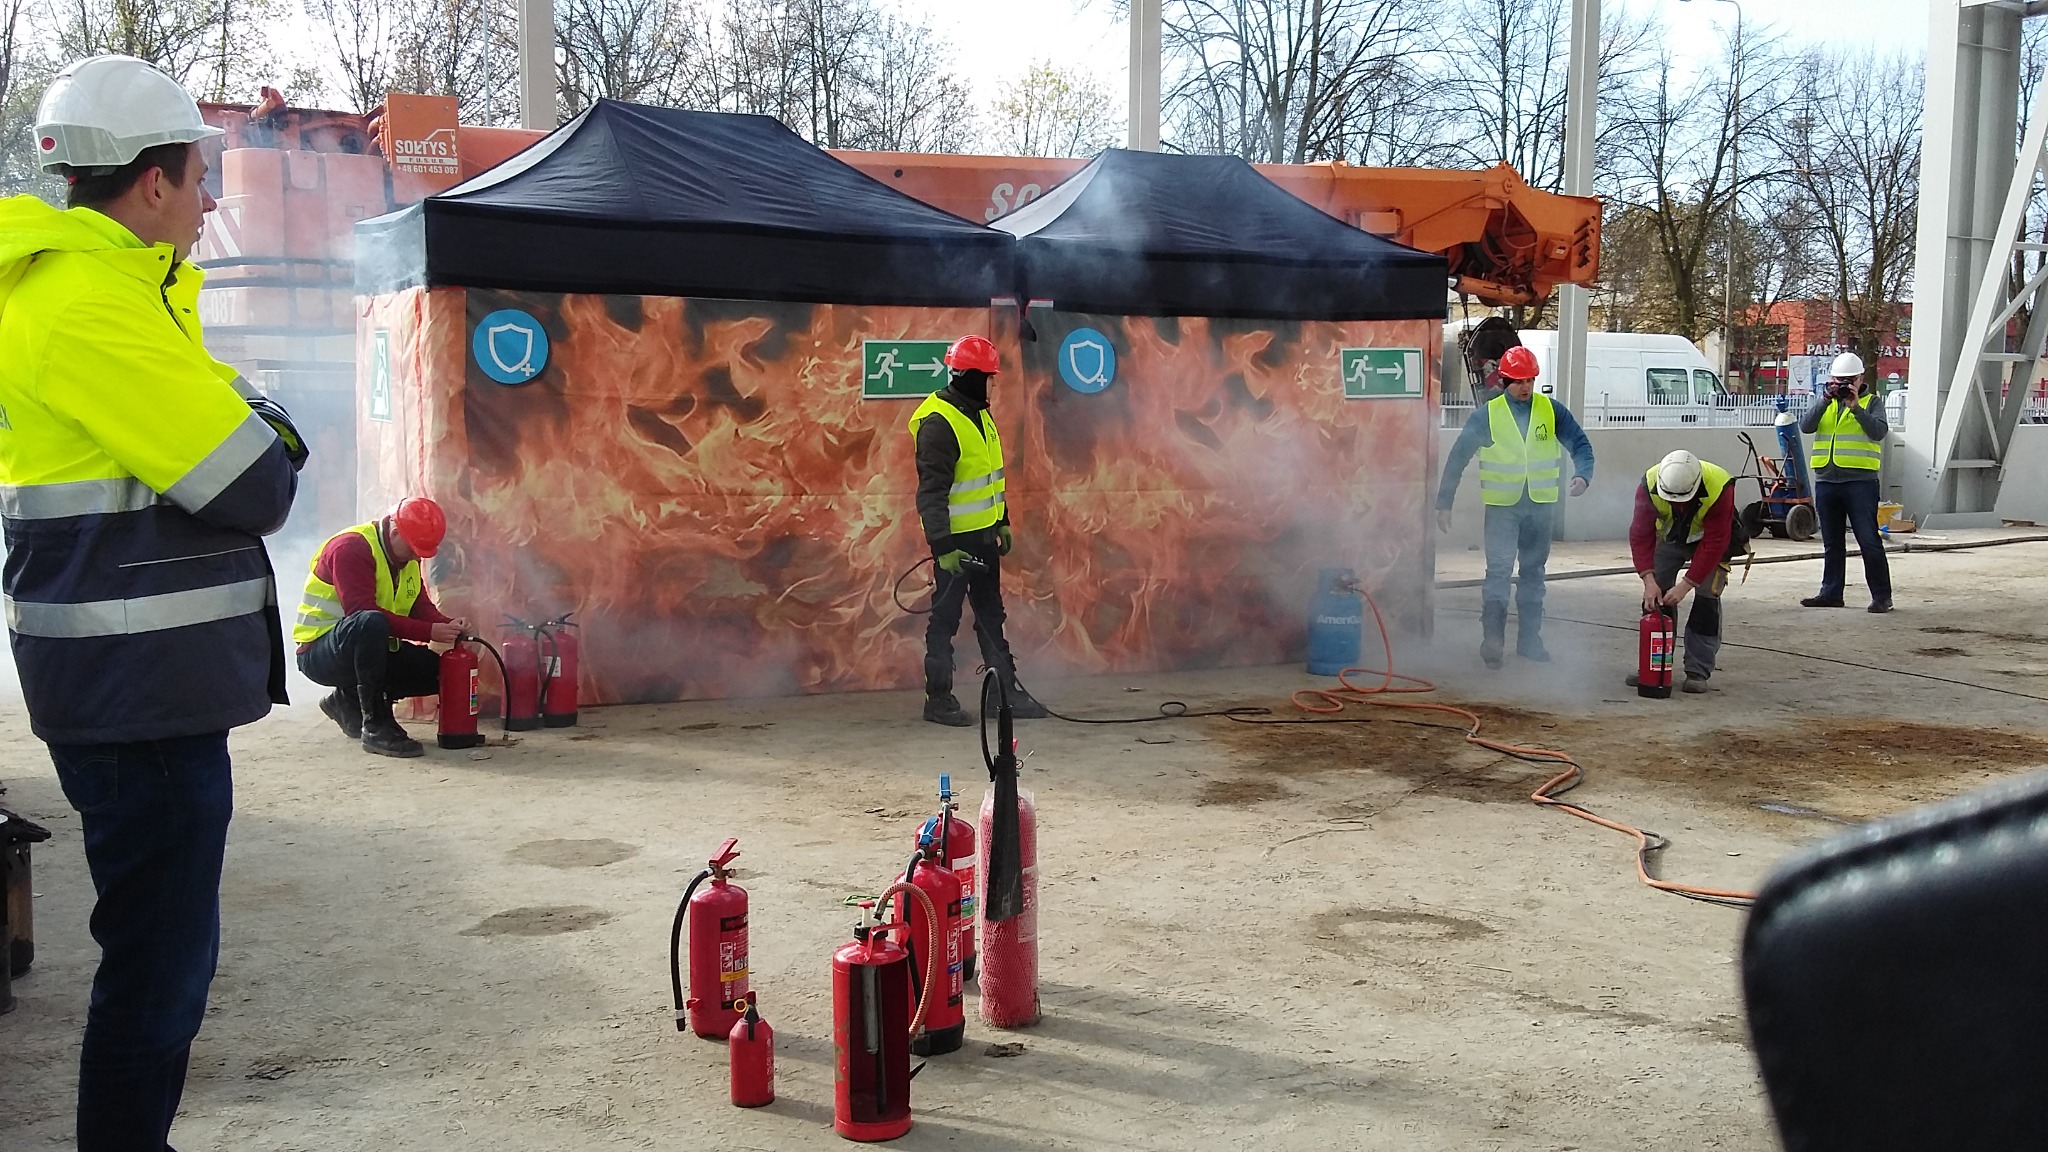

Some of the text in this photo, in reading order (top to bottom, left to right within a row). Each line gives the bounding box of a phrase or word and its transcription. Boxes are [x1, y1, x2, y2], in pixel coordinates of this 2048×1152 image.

[395, 139, 447, 156] SOŁTYS
[397, 165, 459, 174] +48 601 453 087
